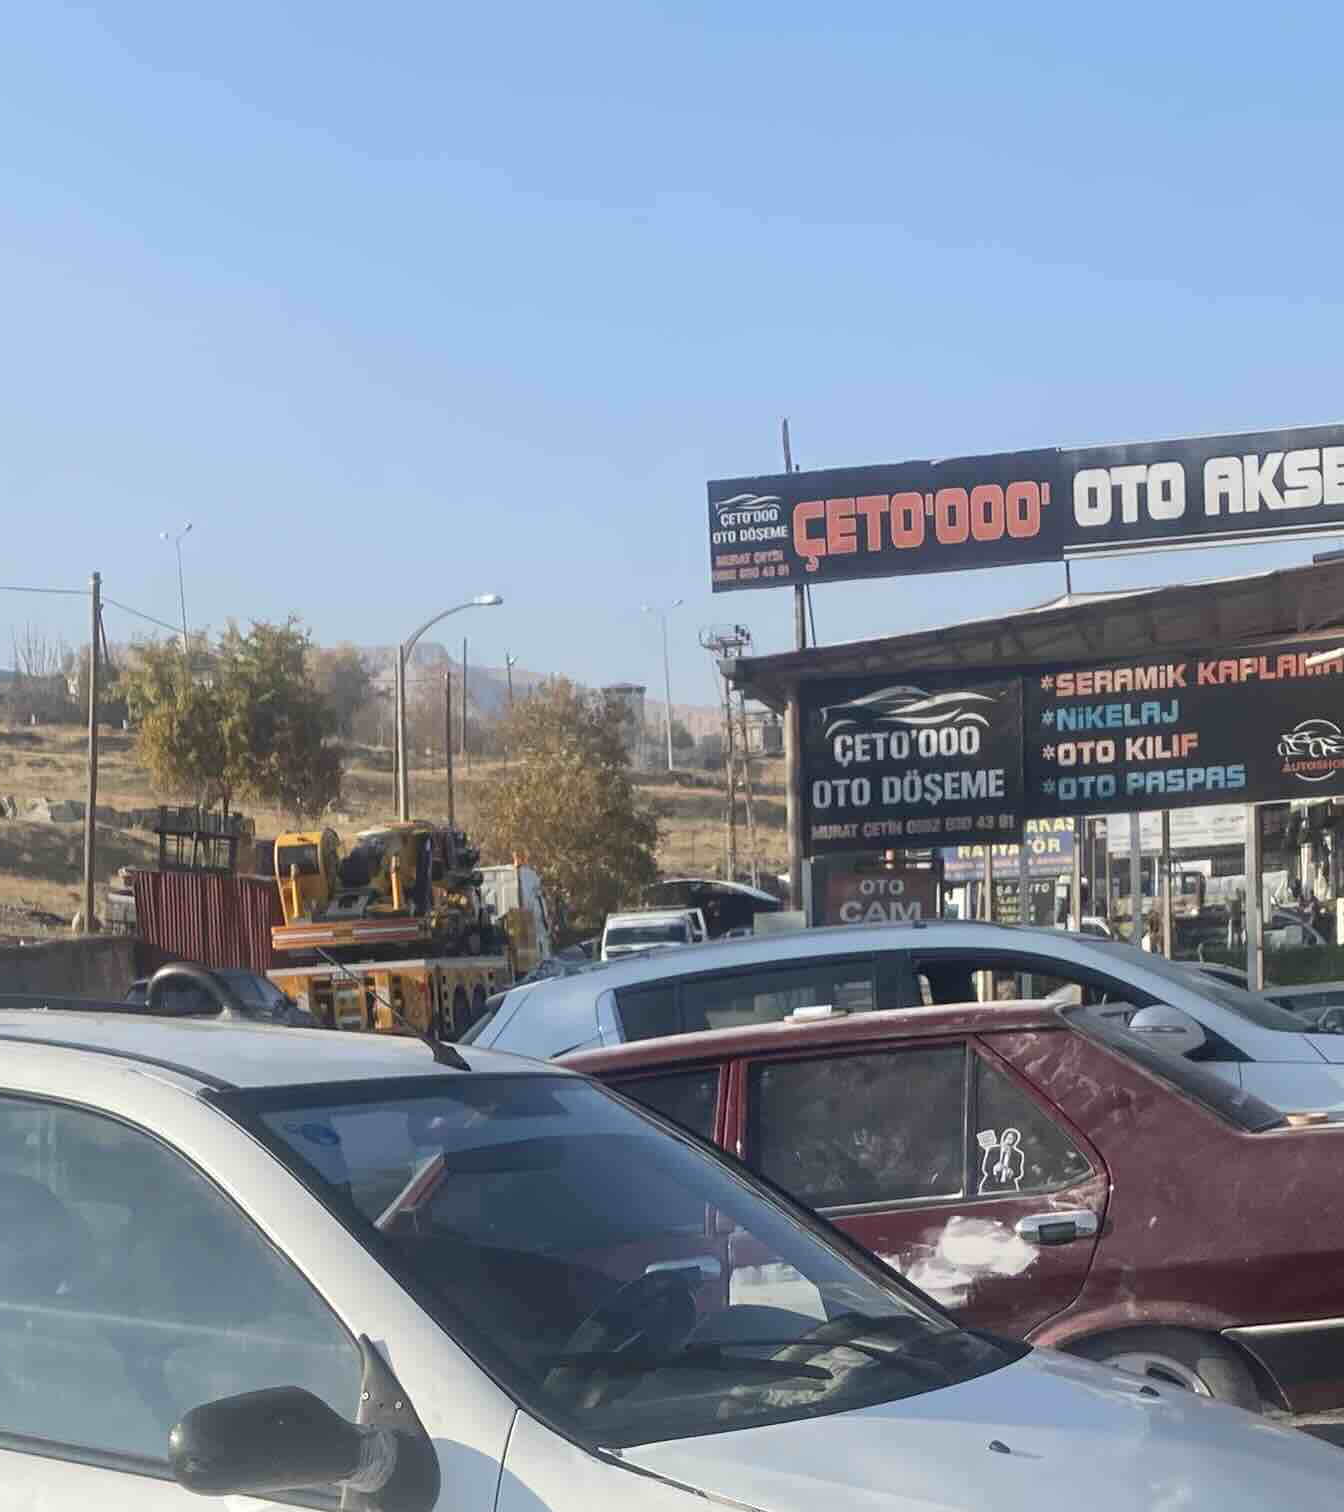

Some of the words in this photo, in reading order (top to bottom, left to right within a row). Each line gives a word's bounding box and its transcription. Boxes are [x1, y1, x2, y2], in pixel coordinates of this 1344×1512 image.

[1073, 461, 1185, 527] OTO
[713, 531, 736, 544] OTO
[739, 525, 788, 541] DÖŞEME
[1056, 740, 1116, 766] OTO
[1125, 732, 1199, 761] KILIF
[812, 777, 871, 808] OTO
[882, 769, 1005, 805] DÖŞEME
[1057, 775, 1116, 800] OTO
[1126, 764, 1246, 795] PASPAS
[860, 879, 904, 895] OTO
[840, 901, 921, 923] CAM
